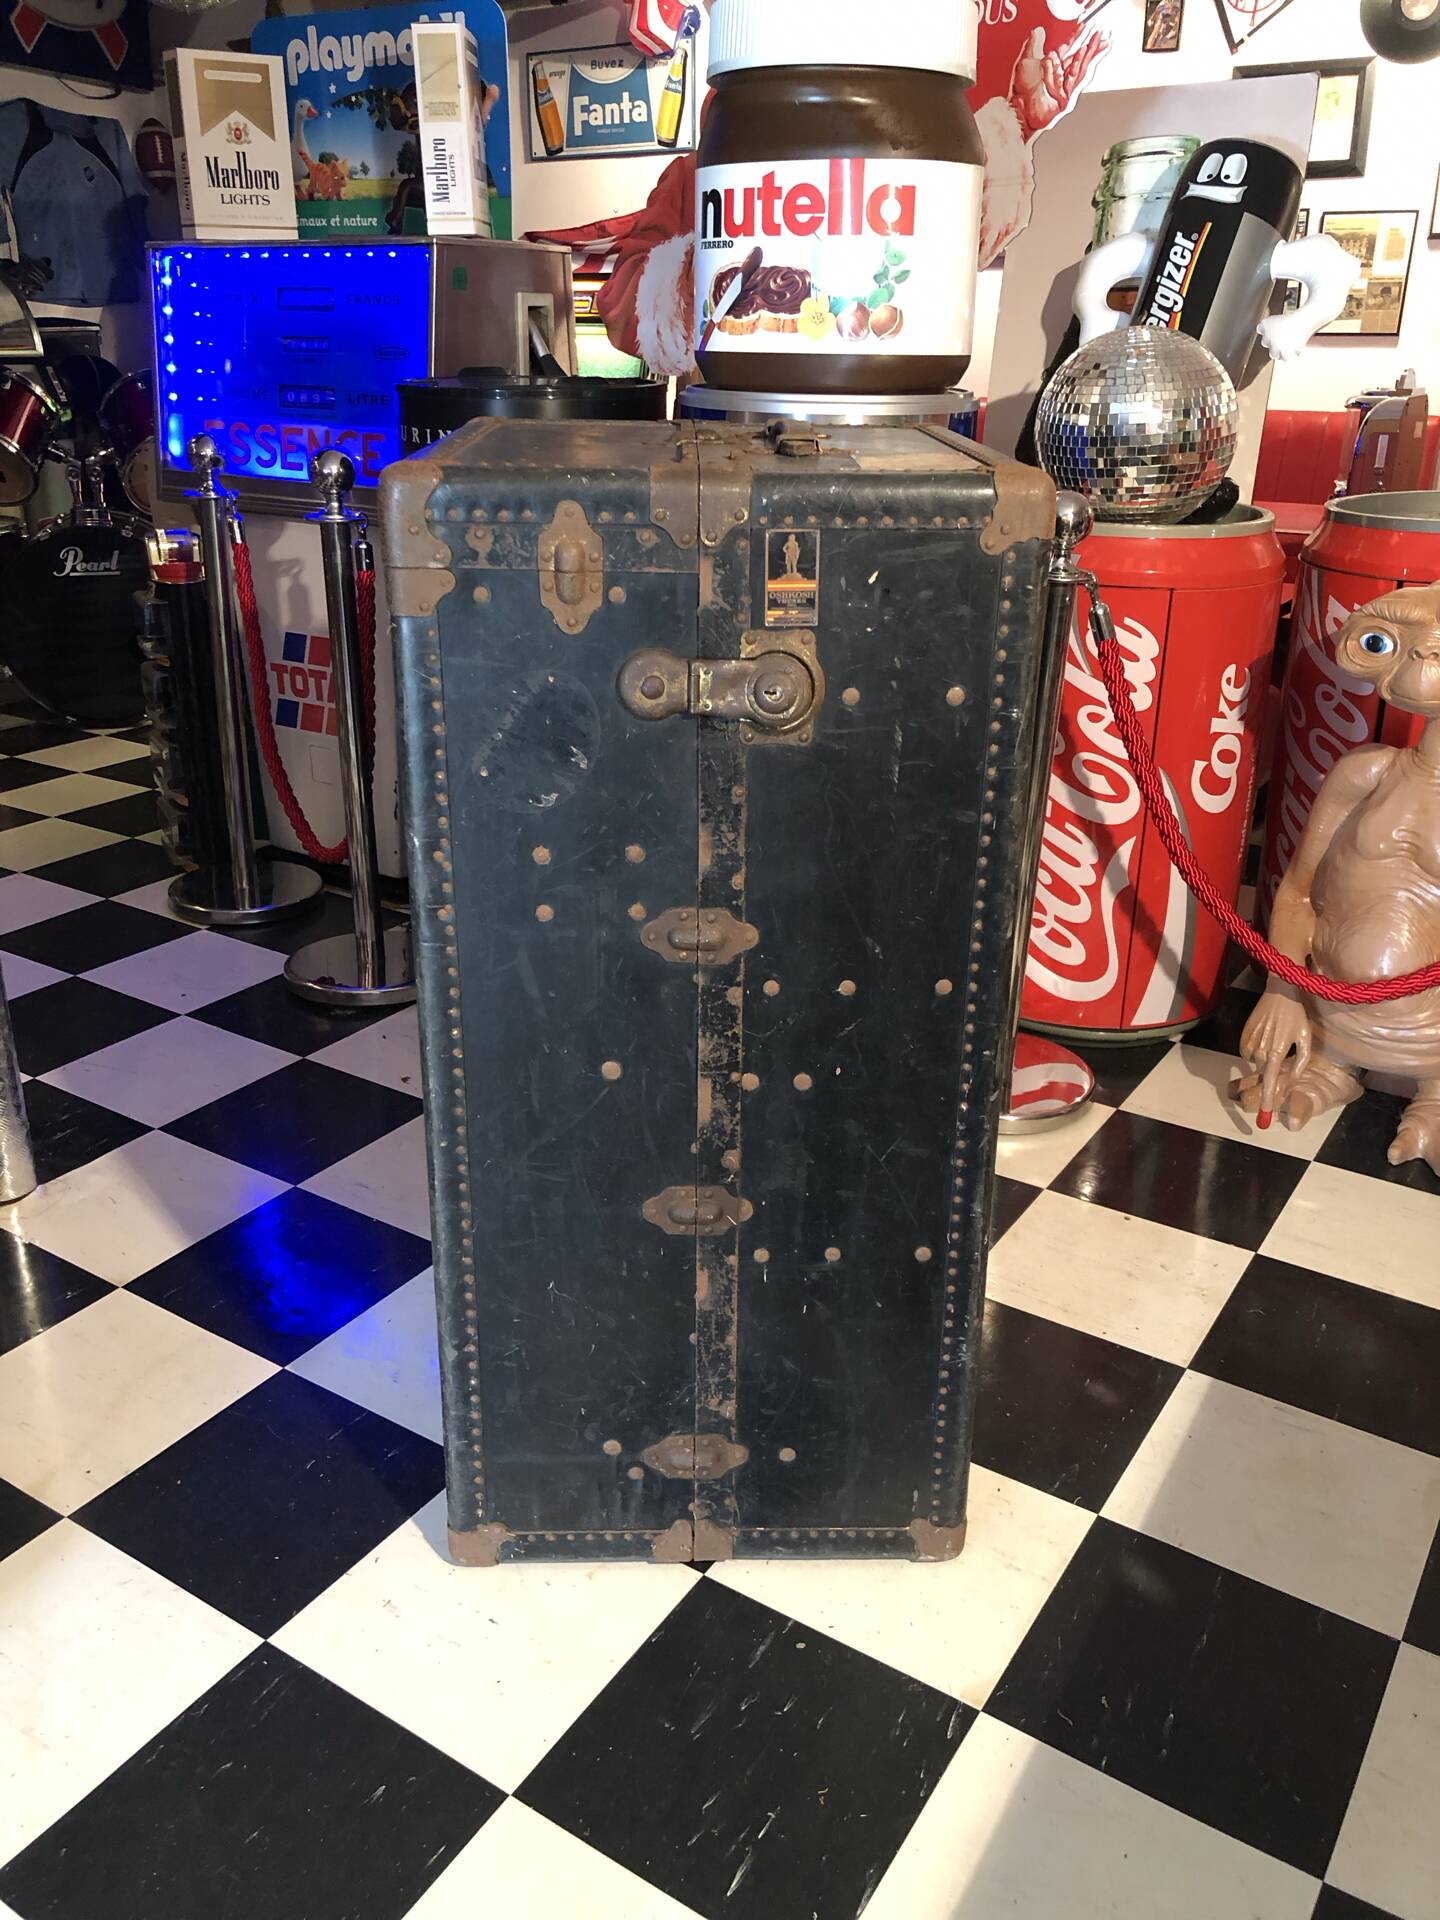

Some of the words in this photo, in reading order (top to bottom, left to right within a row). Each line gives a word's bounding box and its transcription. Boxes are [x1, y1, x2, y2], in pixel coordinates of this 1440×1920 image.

[287, 11, 466, 86] playmo
[573, 91, 648, 136] Fanta
[204, 151, 280, 190] Marlboro
[425, 138, 450, 203] Marlboro
[449, 154, 457, 187] LIGHTS
[220, 193, 271, 206] LIGHTS
[701, 158, 917, 239] nutella
[330, 214, 341, 227] et
[343, 214, 378, 227] nature
[700, 240, 734, 250] FERRERO
[204, 420, 385, 478] SSENE
[53, 546, 120, 577] Pearl
[1191, 663, 1250, 814] Coke
